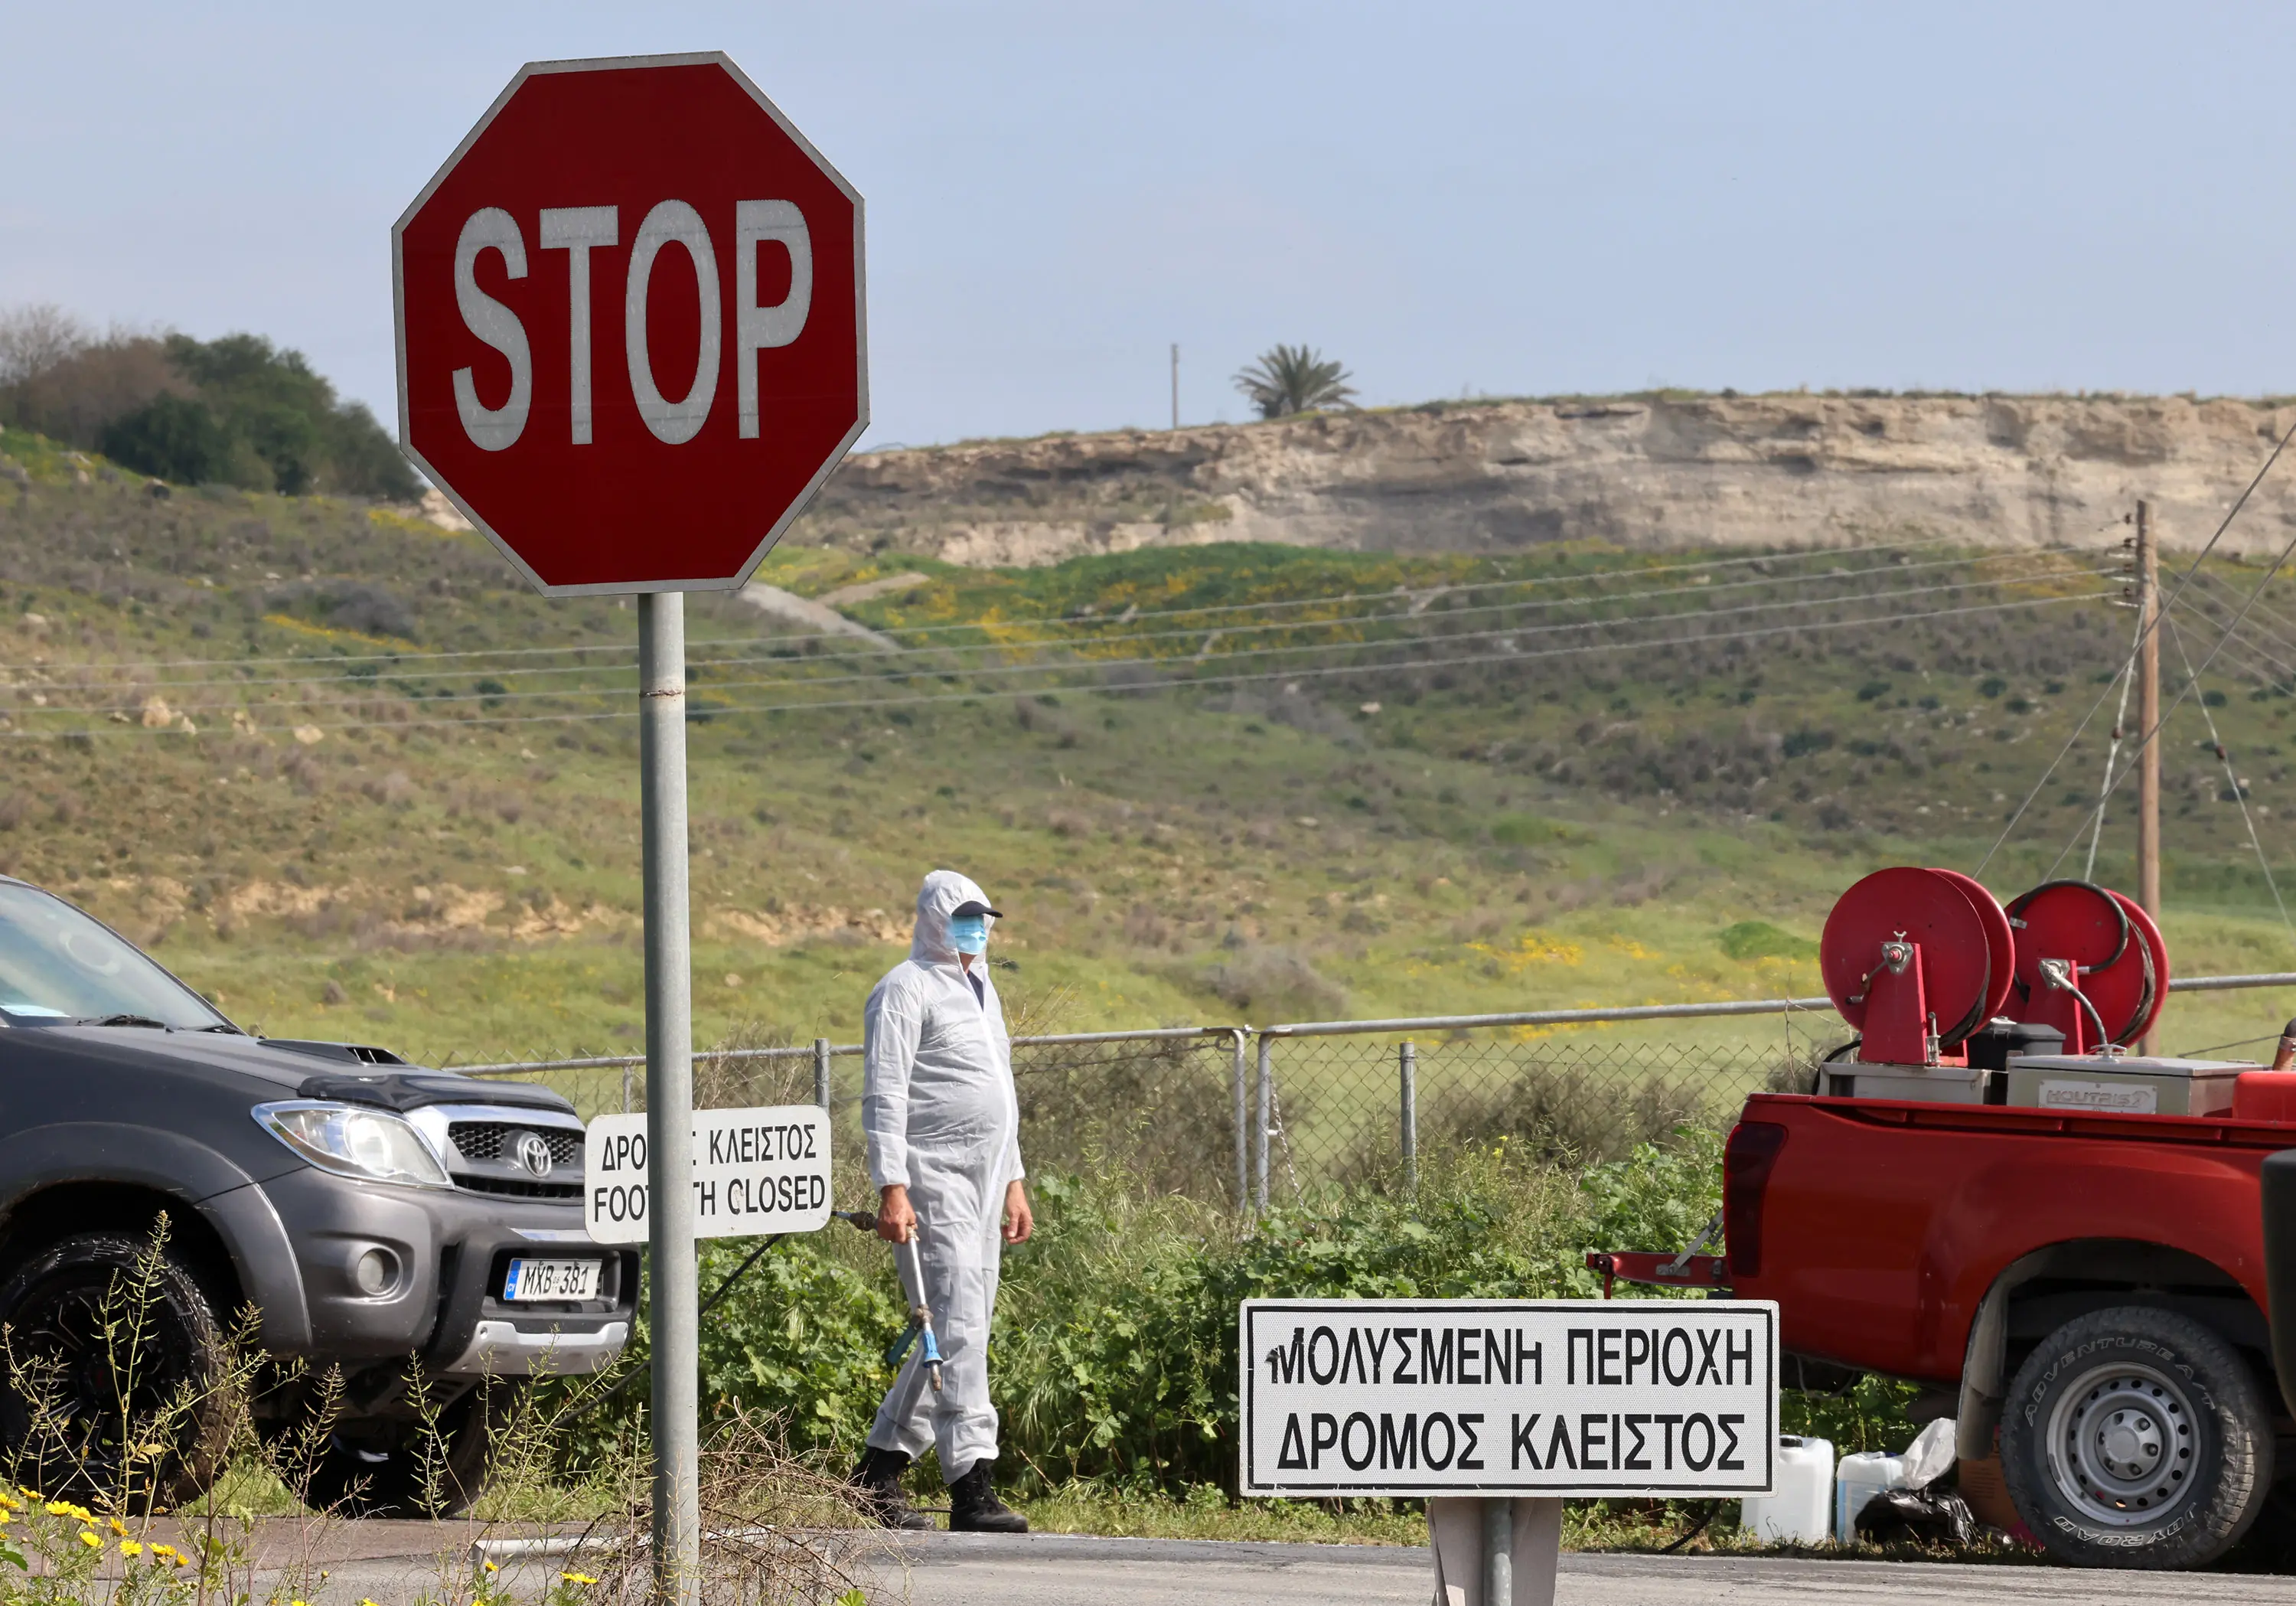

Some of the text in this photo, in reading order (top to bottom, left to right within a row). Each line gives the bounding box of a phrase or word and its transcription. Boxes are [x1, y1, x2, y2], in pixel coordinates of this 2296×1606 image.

[452, 199, 813, 452] STOP
[602, 1124, 817, 1171] ΔΡΟ ΚΛΕΙΣΤΟΣ
[594, 1174, 826, 1222] FOOH CLOSED
[507, 1283, 517, 1293] CY
[522, 1265, 589, 1295] MXB 381
[1265, 1325, 1753, 1386] ΜΟΛΥΣΜΕΝΗ ΠΕΡΙΟΧΗ
[2024, 1337, 2175, 1428] ADVENTURE
[1277, 1412, 1745, 1471] ΔΡΟΜΟΣ ΚΛΕΙΣΤΟΣ
